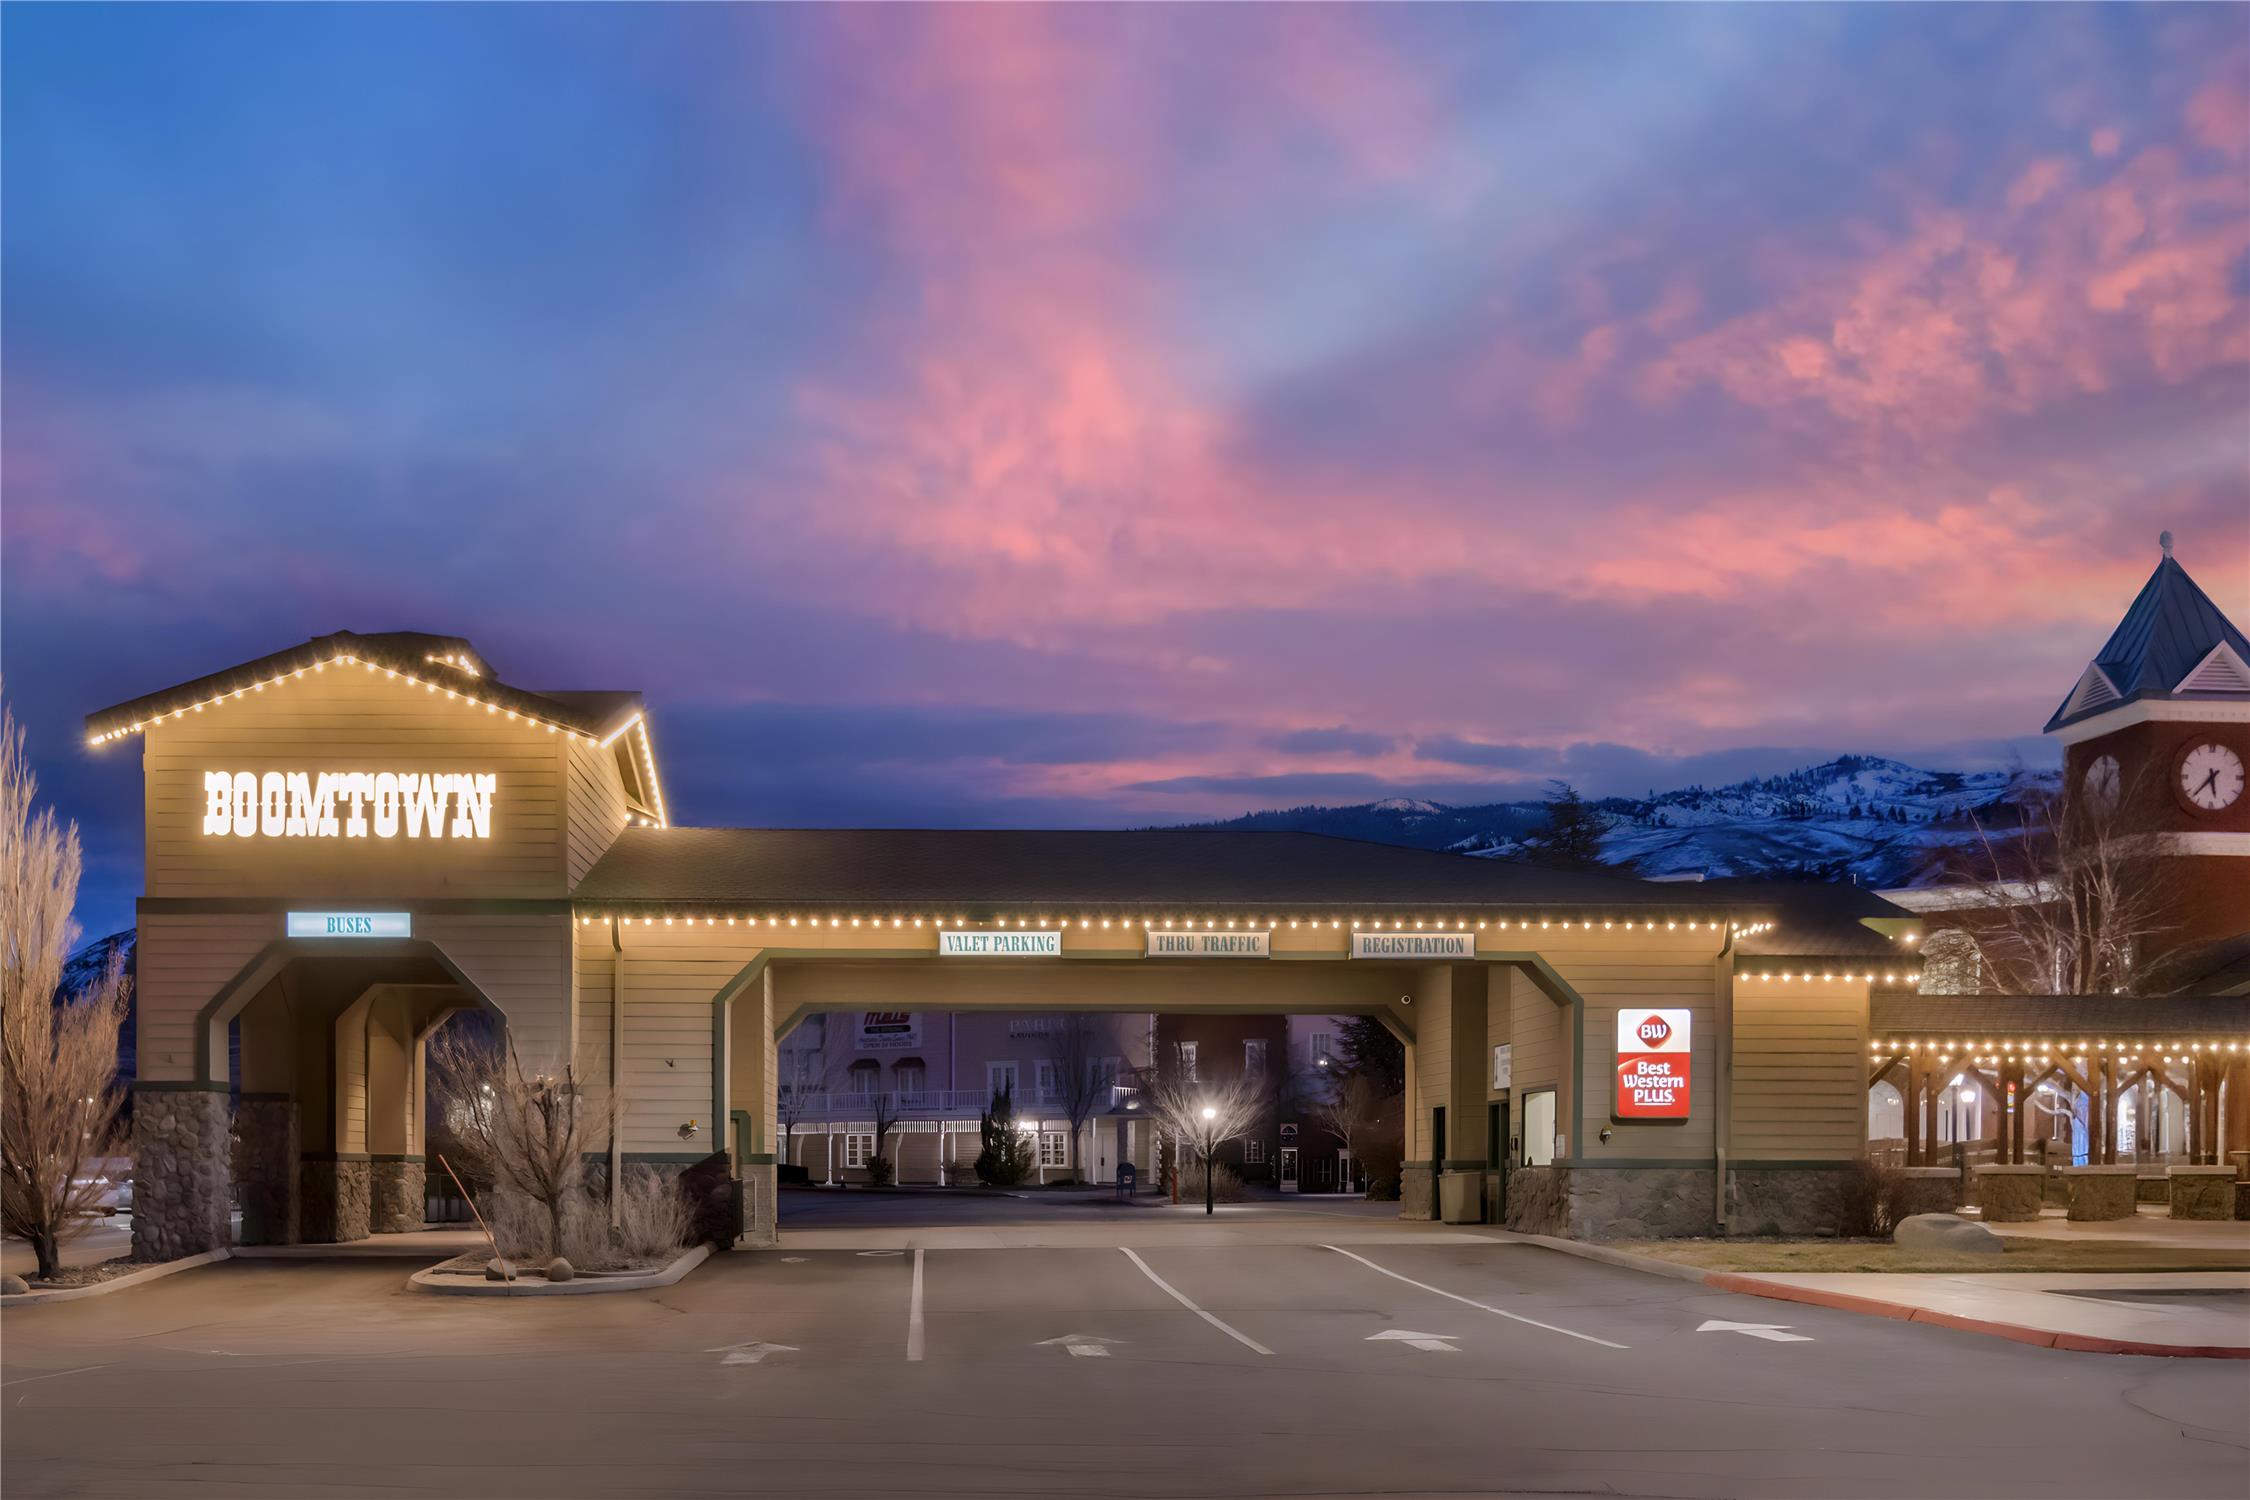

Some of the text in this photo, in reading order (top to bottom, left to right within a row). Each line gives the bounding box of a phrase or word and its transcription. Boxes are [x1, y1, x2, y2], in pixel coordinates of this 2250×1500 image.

[203, 771, 496, 838] BOOMTOWN
[327, 917, 372, 933] BUSES
[947, 935, 1055, 952] VALET PARKING
[1156, 935, 1260, 952] THRU TRAFFIC
[1363, 937, 1464, 953] REGISTRATION
[1641, 1024, 1667, 1039] BW
[1637, 1061, 1671, 1075] Best
[1622, 1074, 1684, 1088] Western
